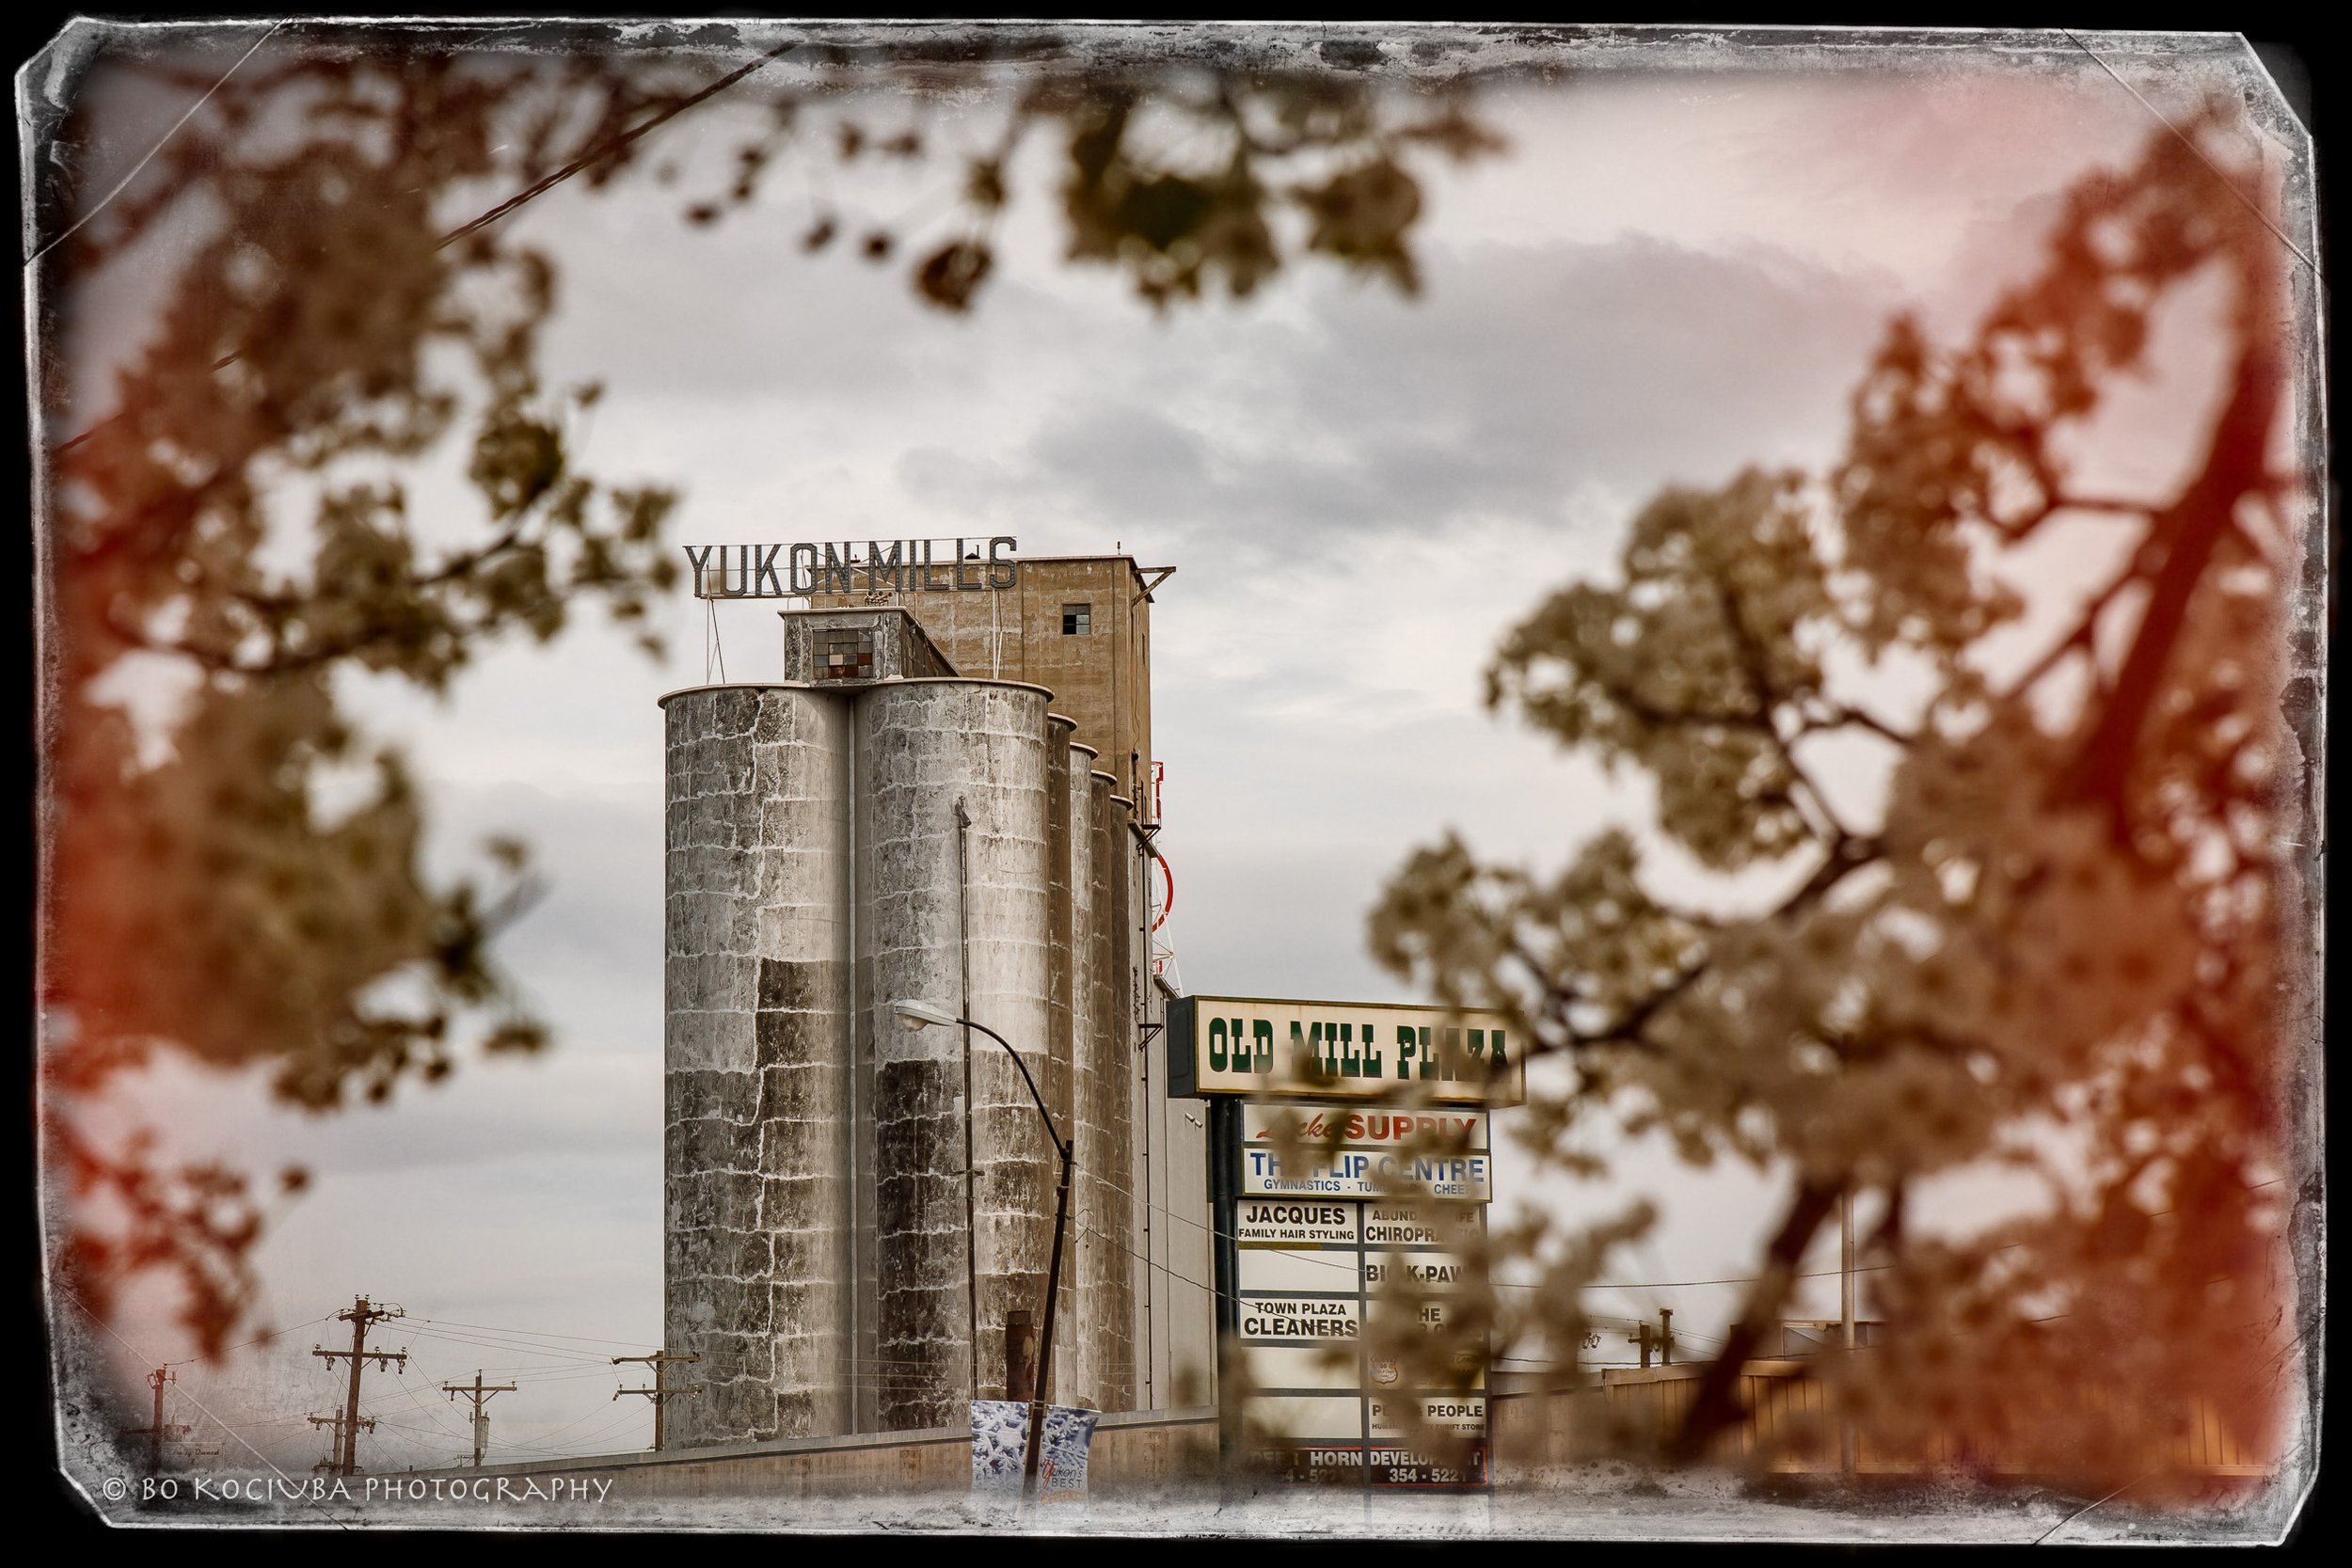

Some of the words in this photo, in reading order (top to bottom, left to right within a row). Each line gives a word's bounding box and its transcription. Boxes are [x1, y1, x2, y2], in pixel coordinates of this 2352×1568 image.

[684, 543, 851, 597] YUKON
[868, 536, 1017, 593] MILLS
[1209, 1017, 1273, 1074] OLD
[1290, 1021, 1382, 1079] MILL
[1344, 1114, 1477, 1141] SUPPLY
[1378, 1156, 1485, 1183] CENTRE
[1263, 1179, 1341, 1192] GYMNASTICS
[1246, 1206, 1345, 1225] JACQUES
[1239, 1228, 1275, 1239] FAMILY
[1279, 1229, 1305, 1239] HAIR
[1309, 1230, 1355, 1240] STYLING
[1255, 1302, 1296, 1314] TOWN
[1302, 1303, 1346, 1315] PLAZA
[1244, 1317, 1359, 1337] CLEANERS
[1427, 1404, 1484, 1418] PEOPLE
[1310, 1451, 1362, 1466] HORN
[1370, 1451, 1481, 1466] DEVELOT
[1389, 1468, 1418, 1482] 354
[1051, 1478, 1083, 1489] BEST
